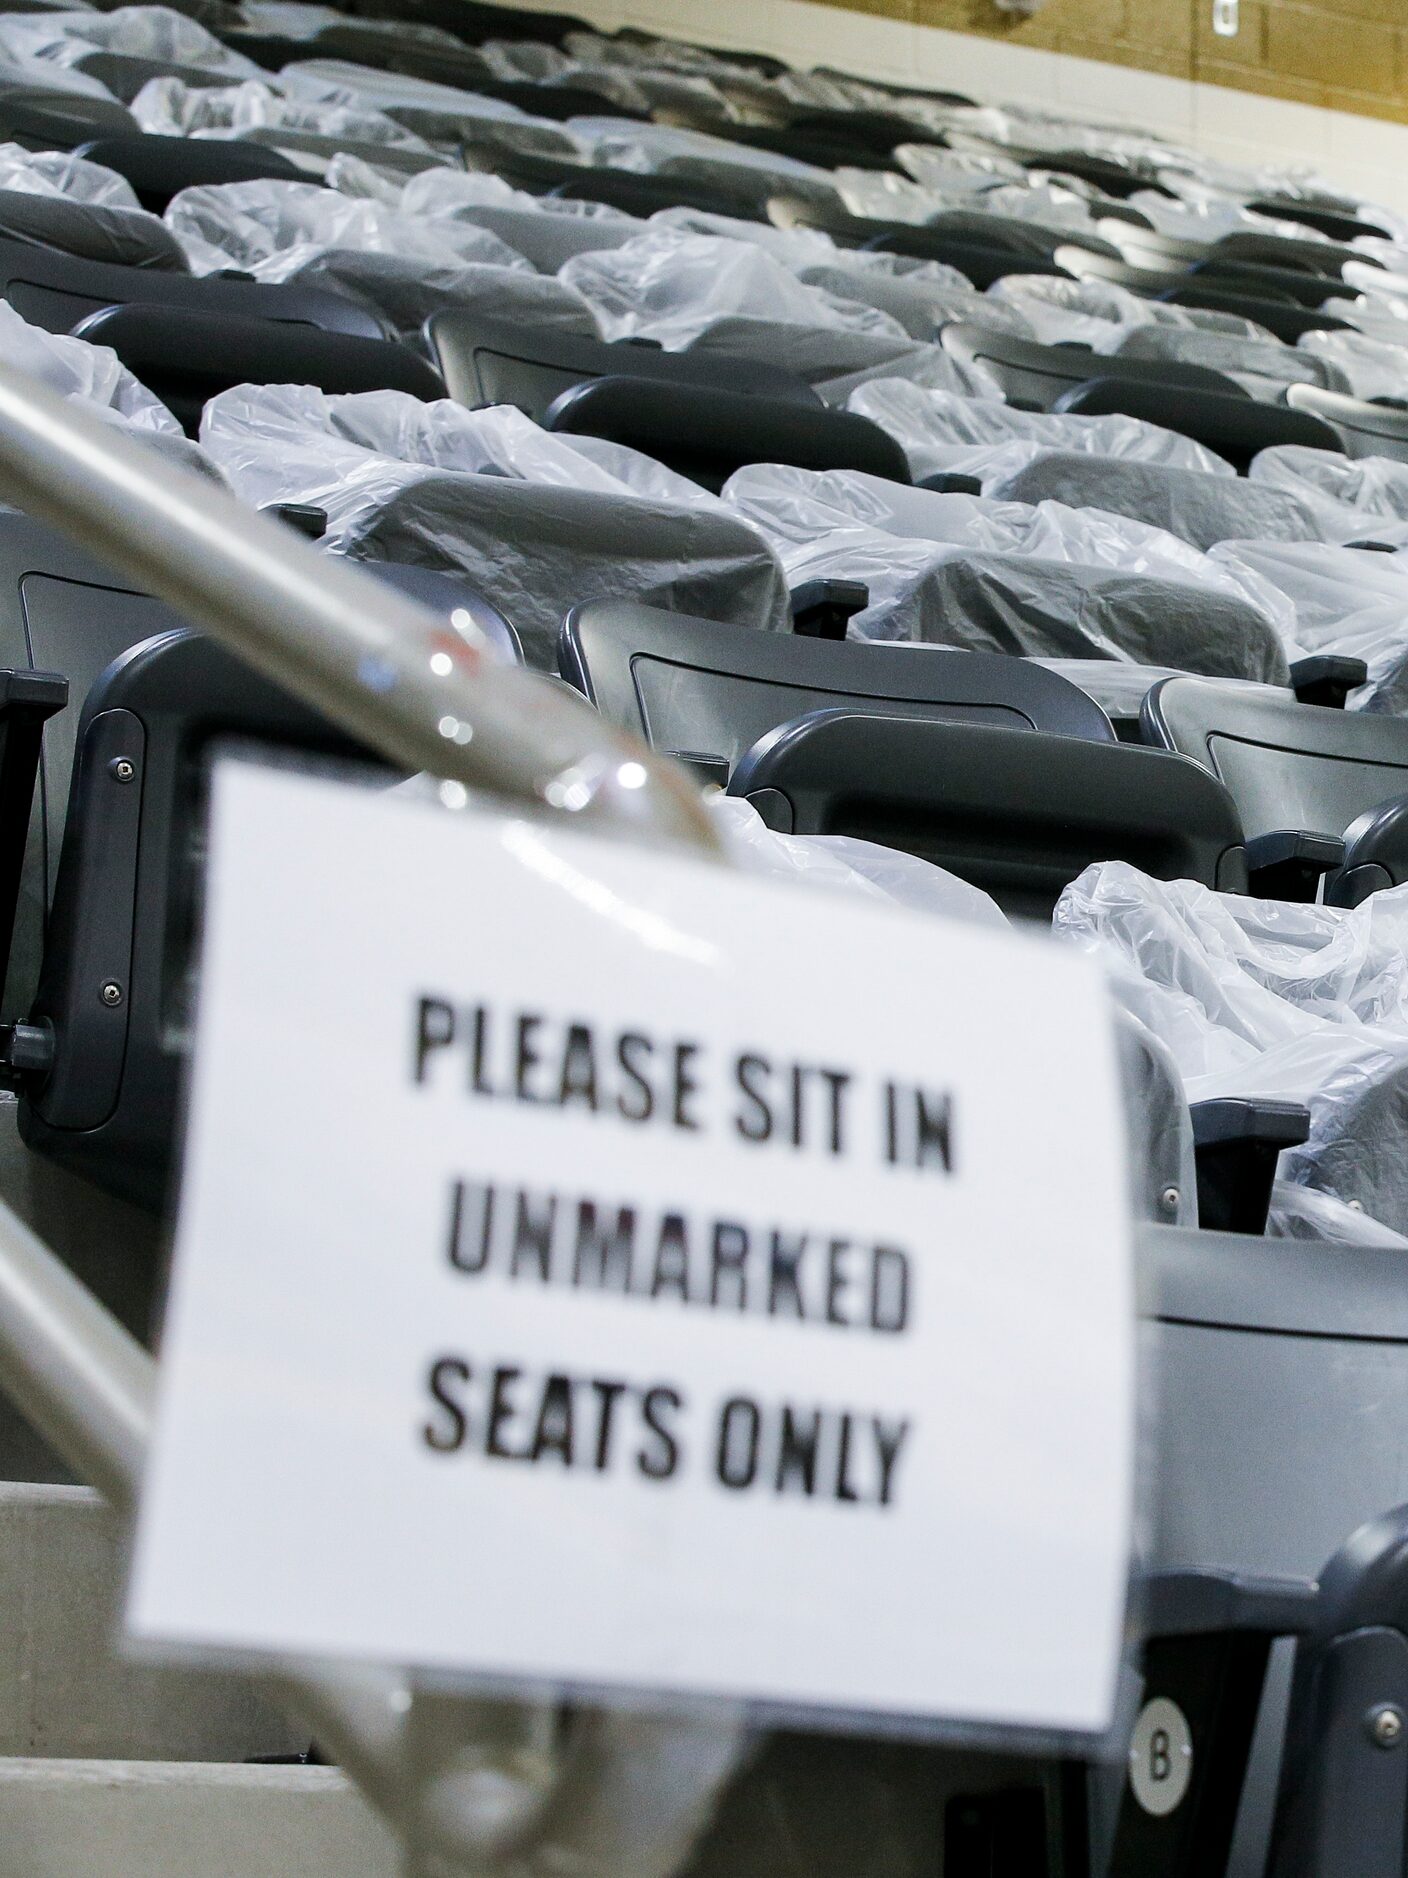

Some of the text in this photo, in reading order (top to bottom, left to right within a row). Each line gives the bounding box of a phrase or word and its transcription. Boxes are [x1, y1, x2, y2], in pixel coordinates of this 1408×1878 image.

[412, 993, 955, 1175] PLEASE SIT IN
[444, 1178, 912, 1336] UNMARKED
[419, 1353, 910, 1510] SEATS ONLY
[1149, 1728, 1171, 1782] B
